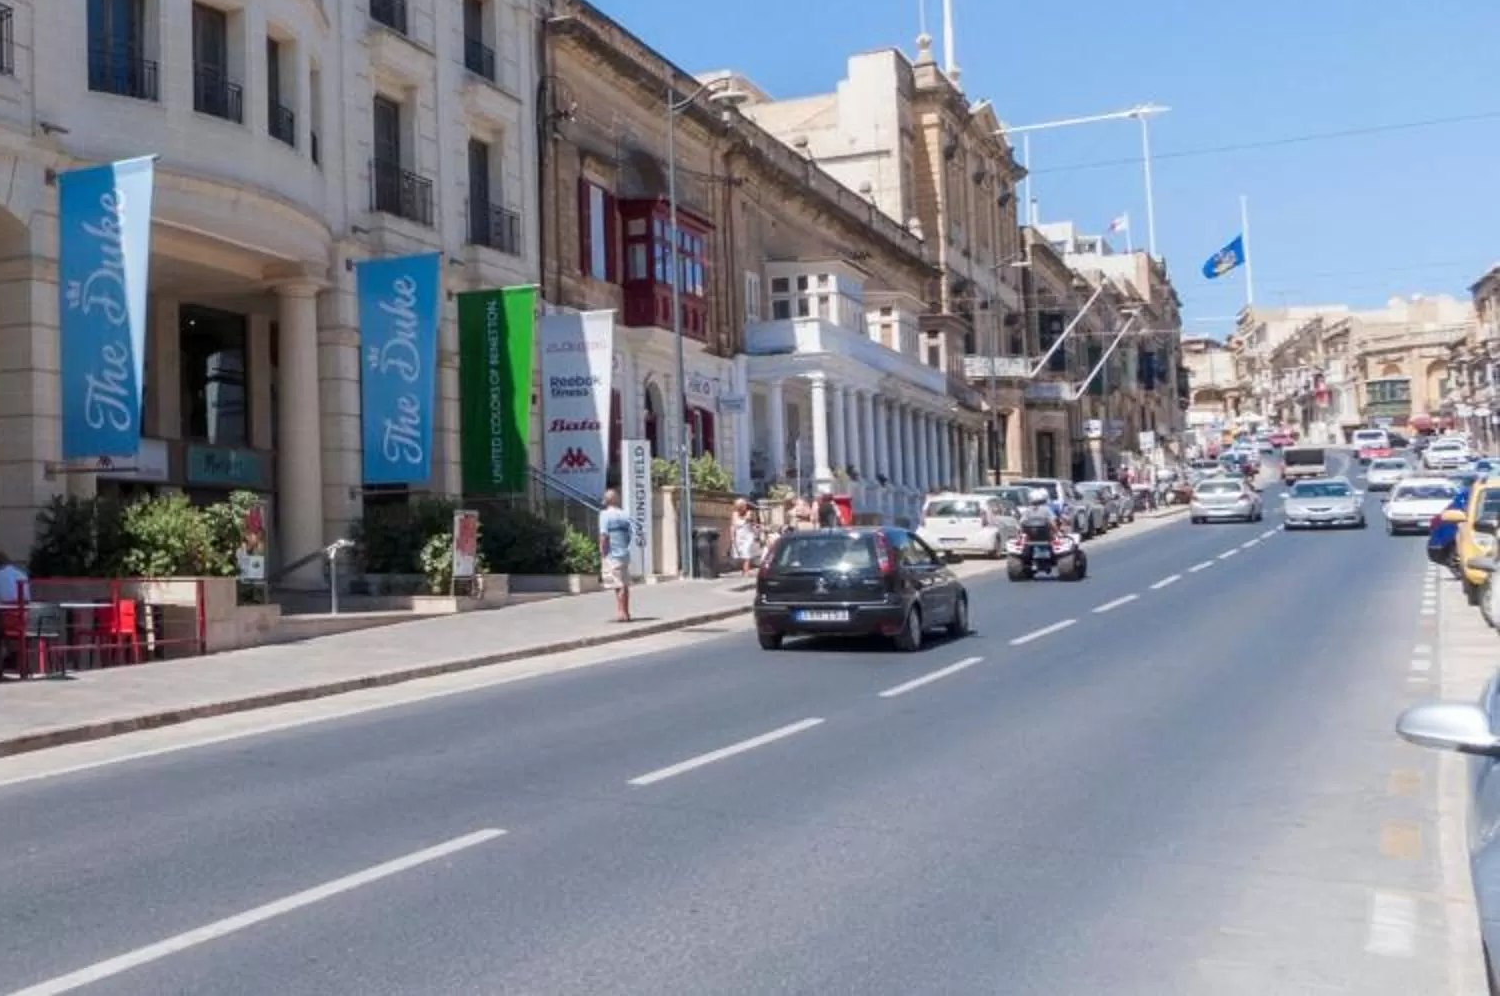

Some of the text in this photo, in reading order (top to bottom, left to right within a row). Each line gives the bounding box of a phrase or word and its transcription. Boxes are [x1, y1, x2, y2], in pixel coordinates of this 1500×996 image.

[80, 188, 132, 432] The Duke
[379, 274, 423, 465] The Duke
[548, 418, 601, 433] Bata
